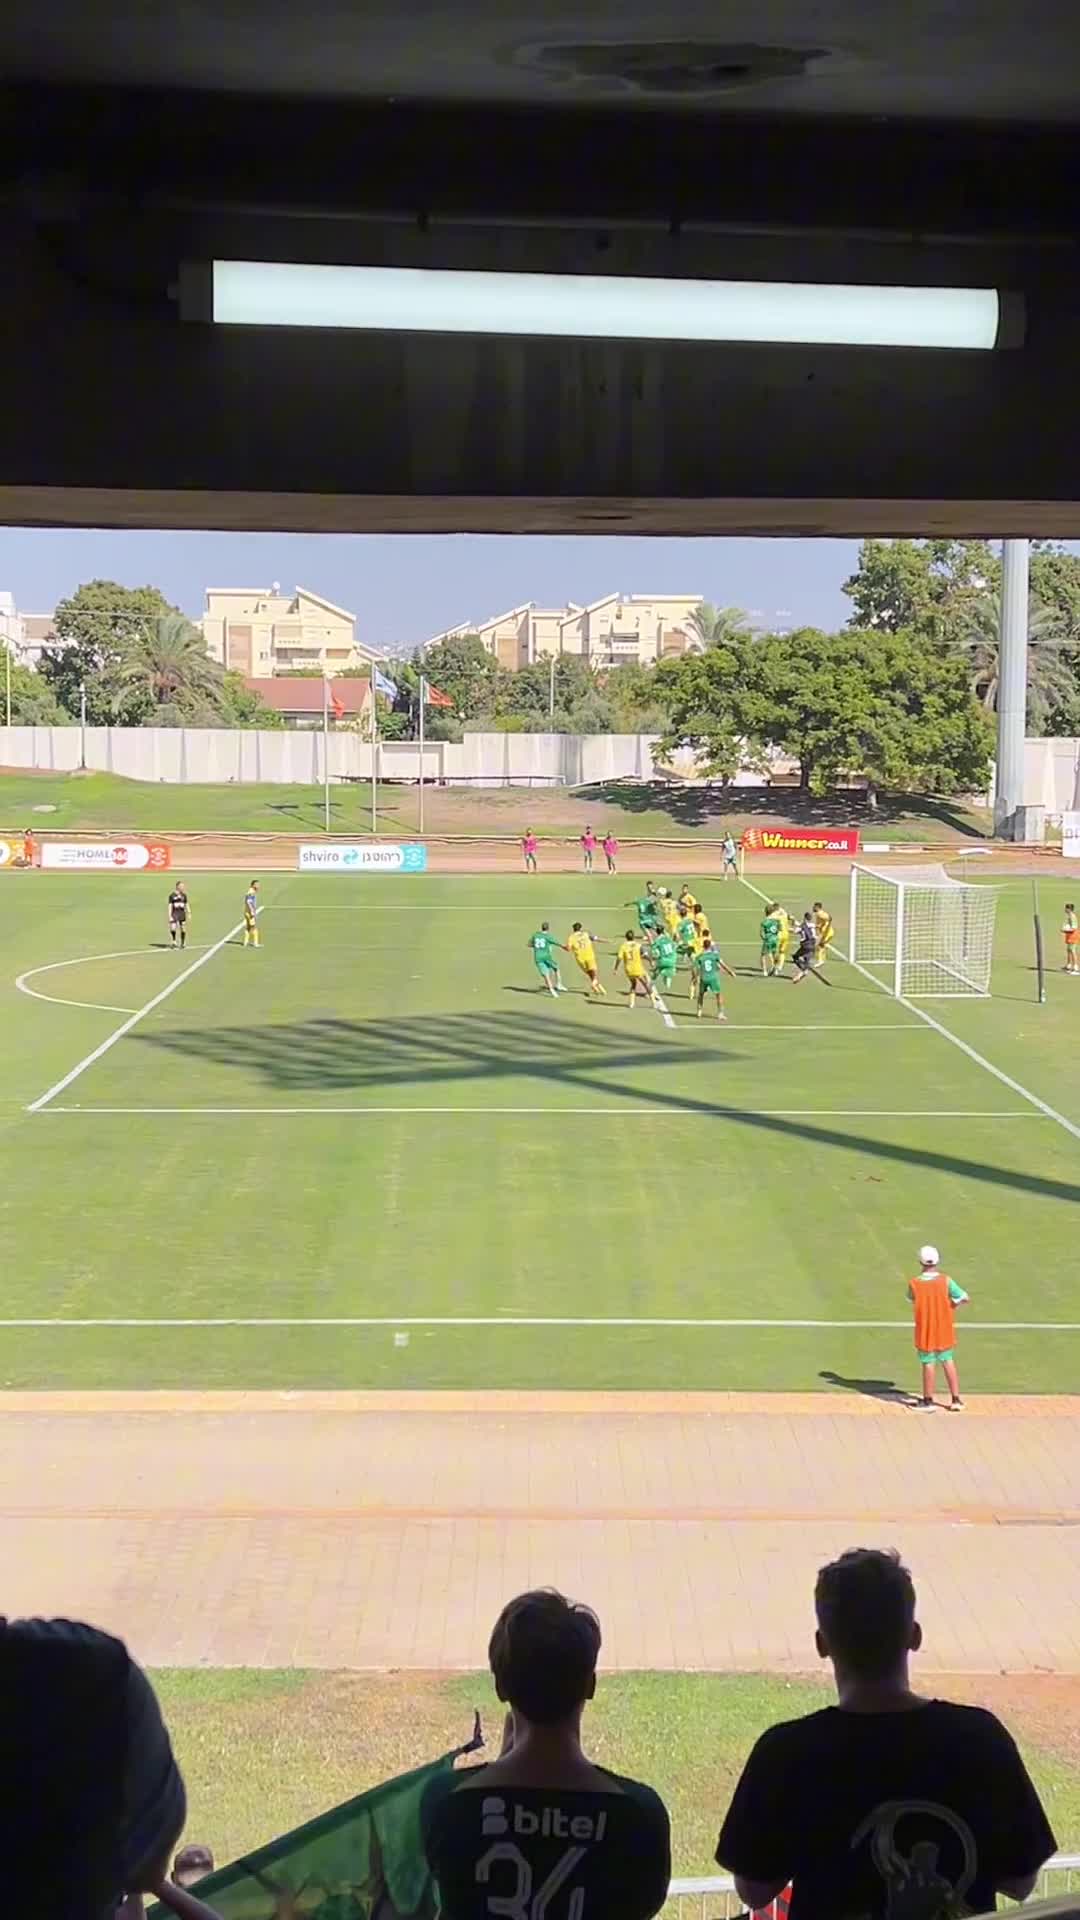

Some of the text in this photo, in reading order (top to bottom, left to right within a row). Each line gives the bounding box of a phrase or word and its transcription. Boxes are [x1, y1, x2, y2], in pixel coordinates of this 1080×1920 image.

[762, 832, 848, 850] Winner.co.il
[303, 850, 339, 862] shviro
[514, 1804, 607, 1841] bitel
